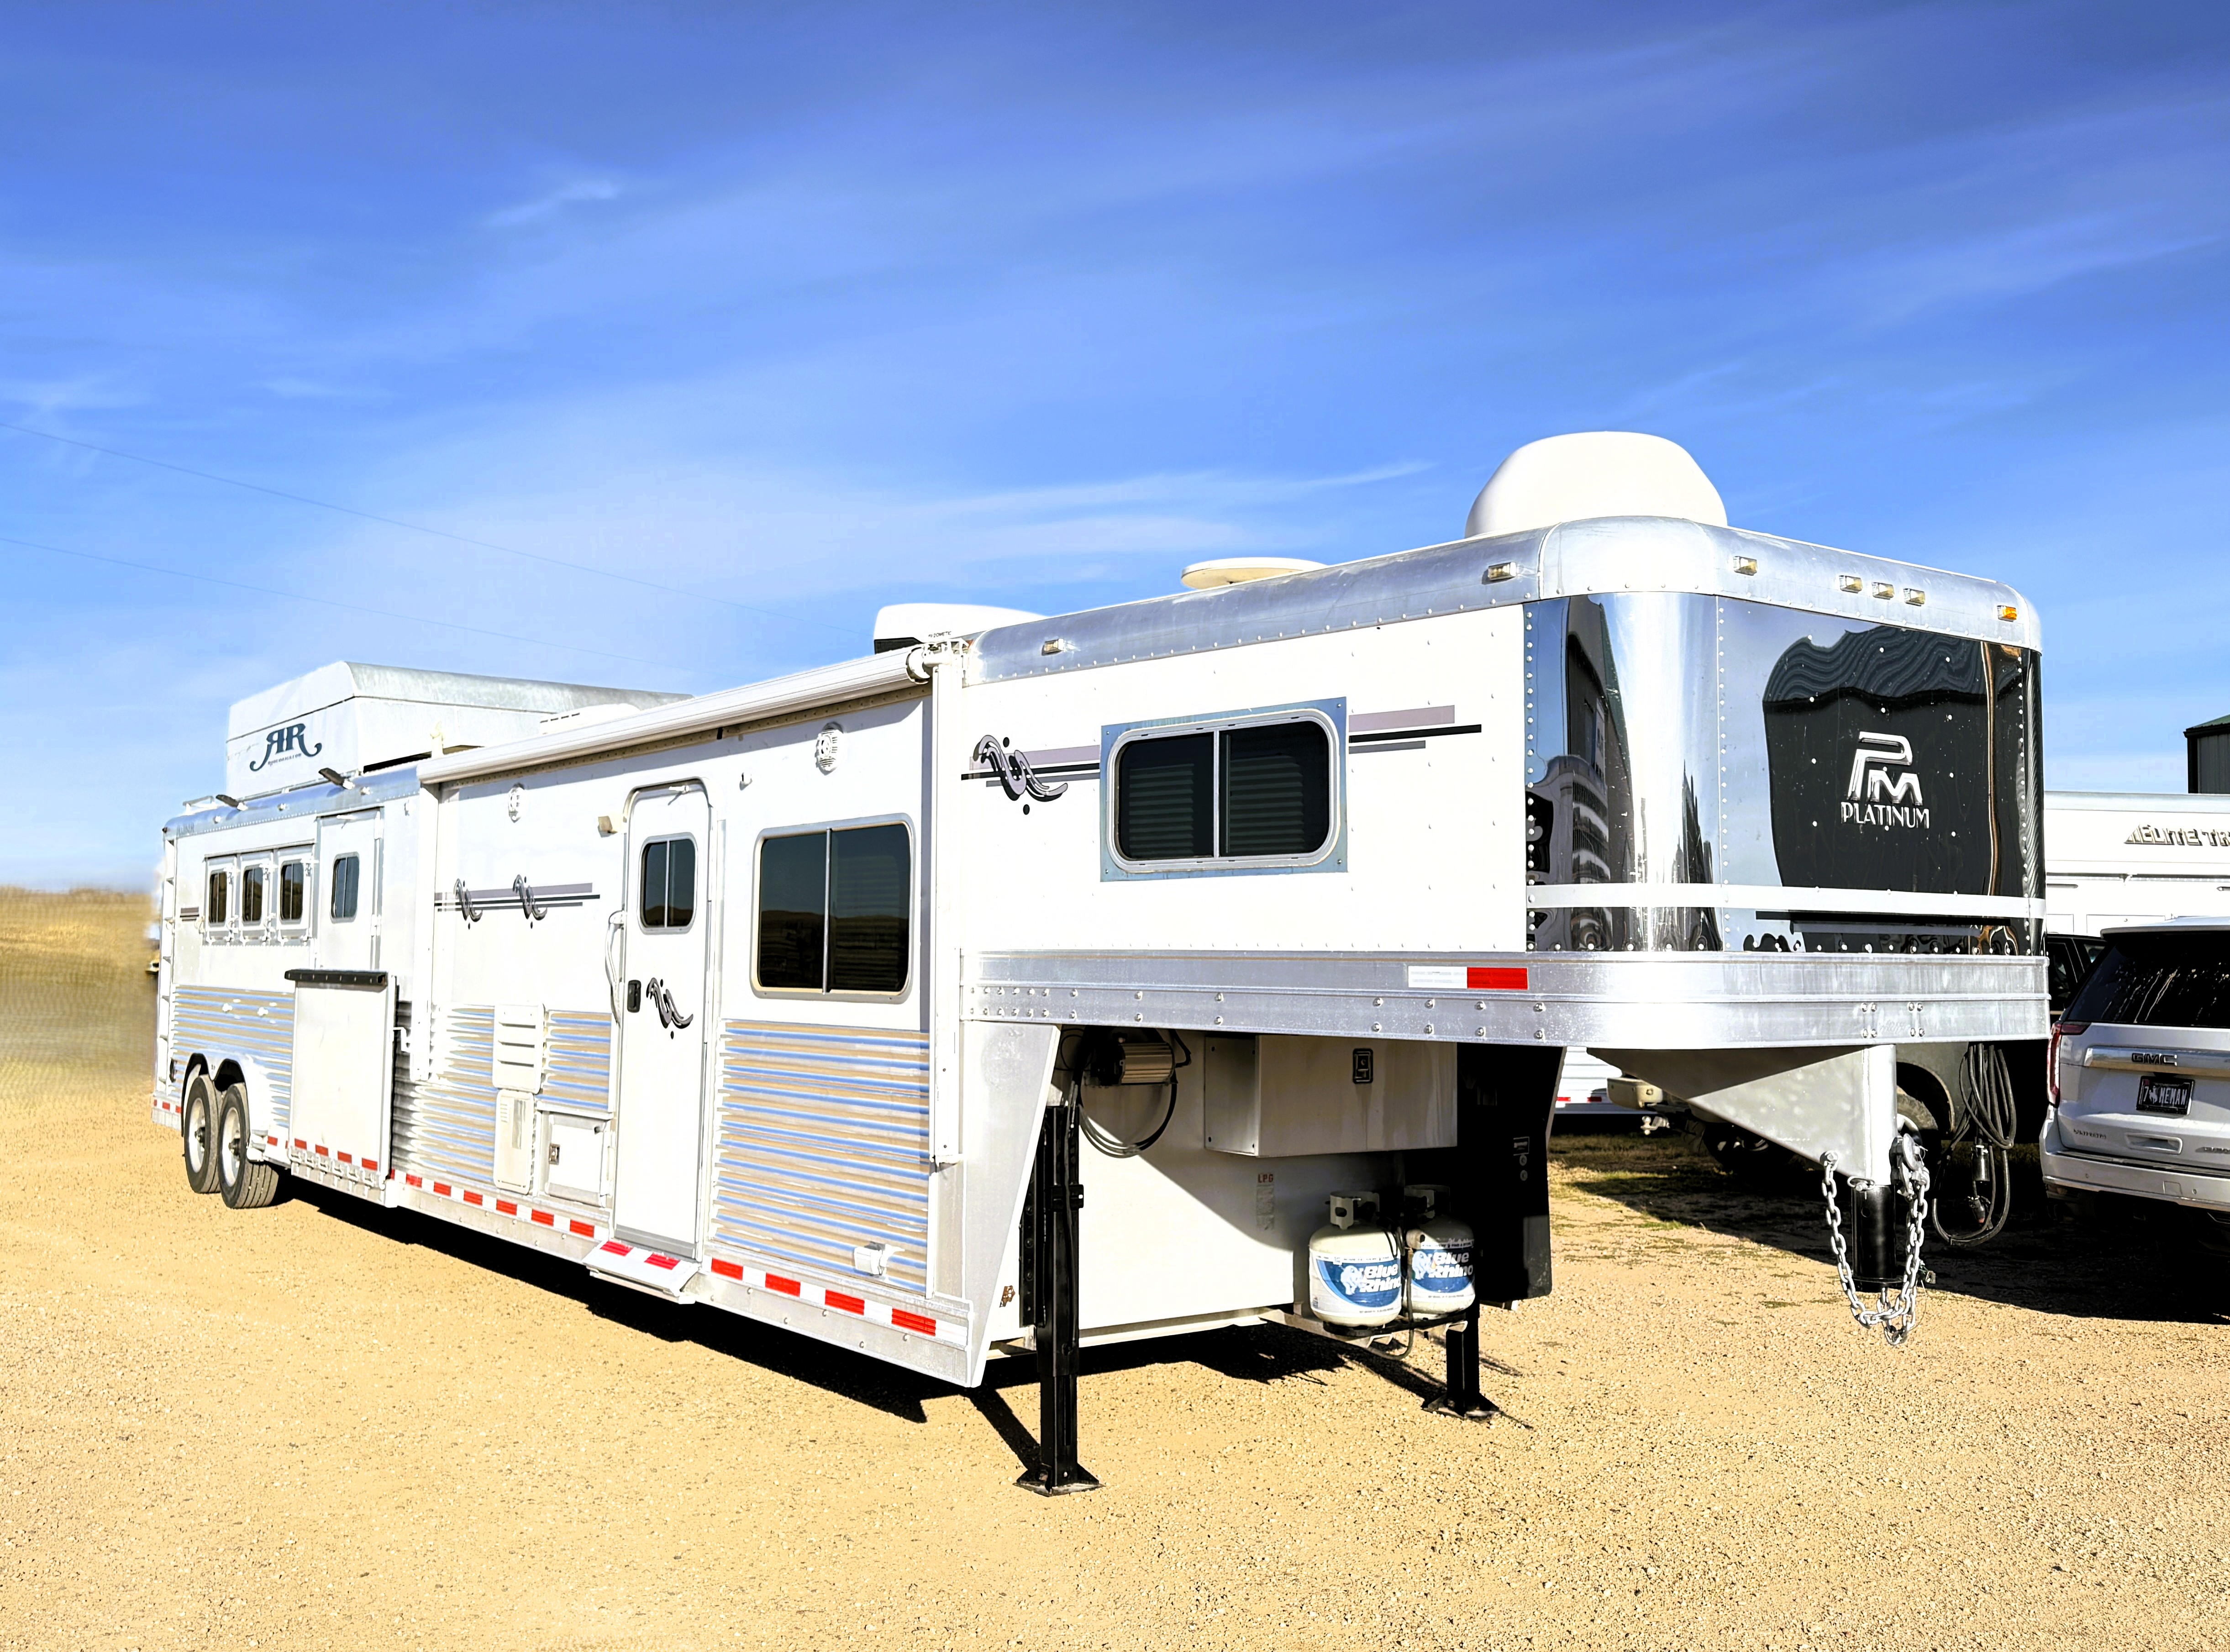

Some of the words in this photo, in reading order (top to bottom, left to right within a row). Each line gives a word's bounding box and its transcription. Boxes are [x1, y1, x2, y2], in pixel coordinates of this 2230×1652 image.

[1841, 801, 1930, 829] PLATINUM
[2124, 824, 2203, 846] ELITE
[2132, 1052, 2177, 1066] GMC
[1258, 1173, 1274, 1183] LPG
[1434, 1252, 1469, 1265] Blue
[1364, 1264, 1398, 1278] Blue
[1428, 1264, 1473, 1278] Rhino
